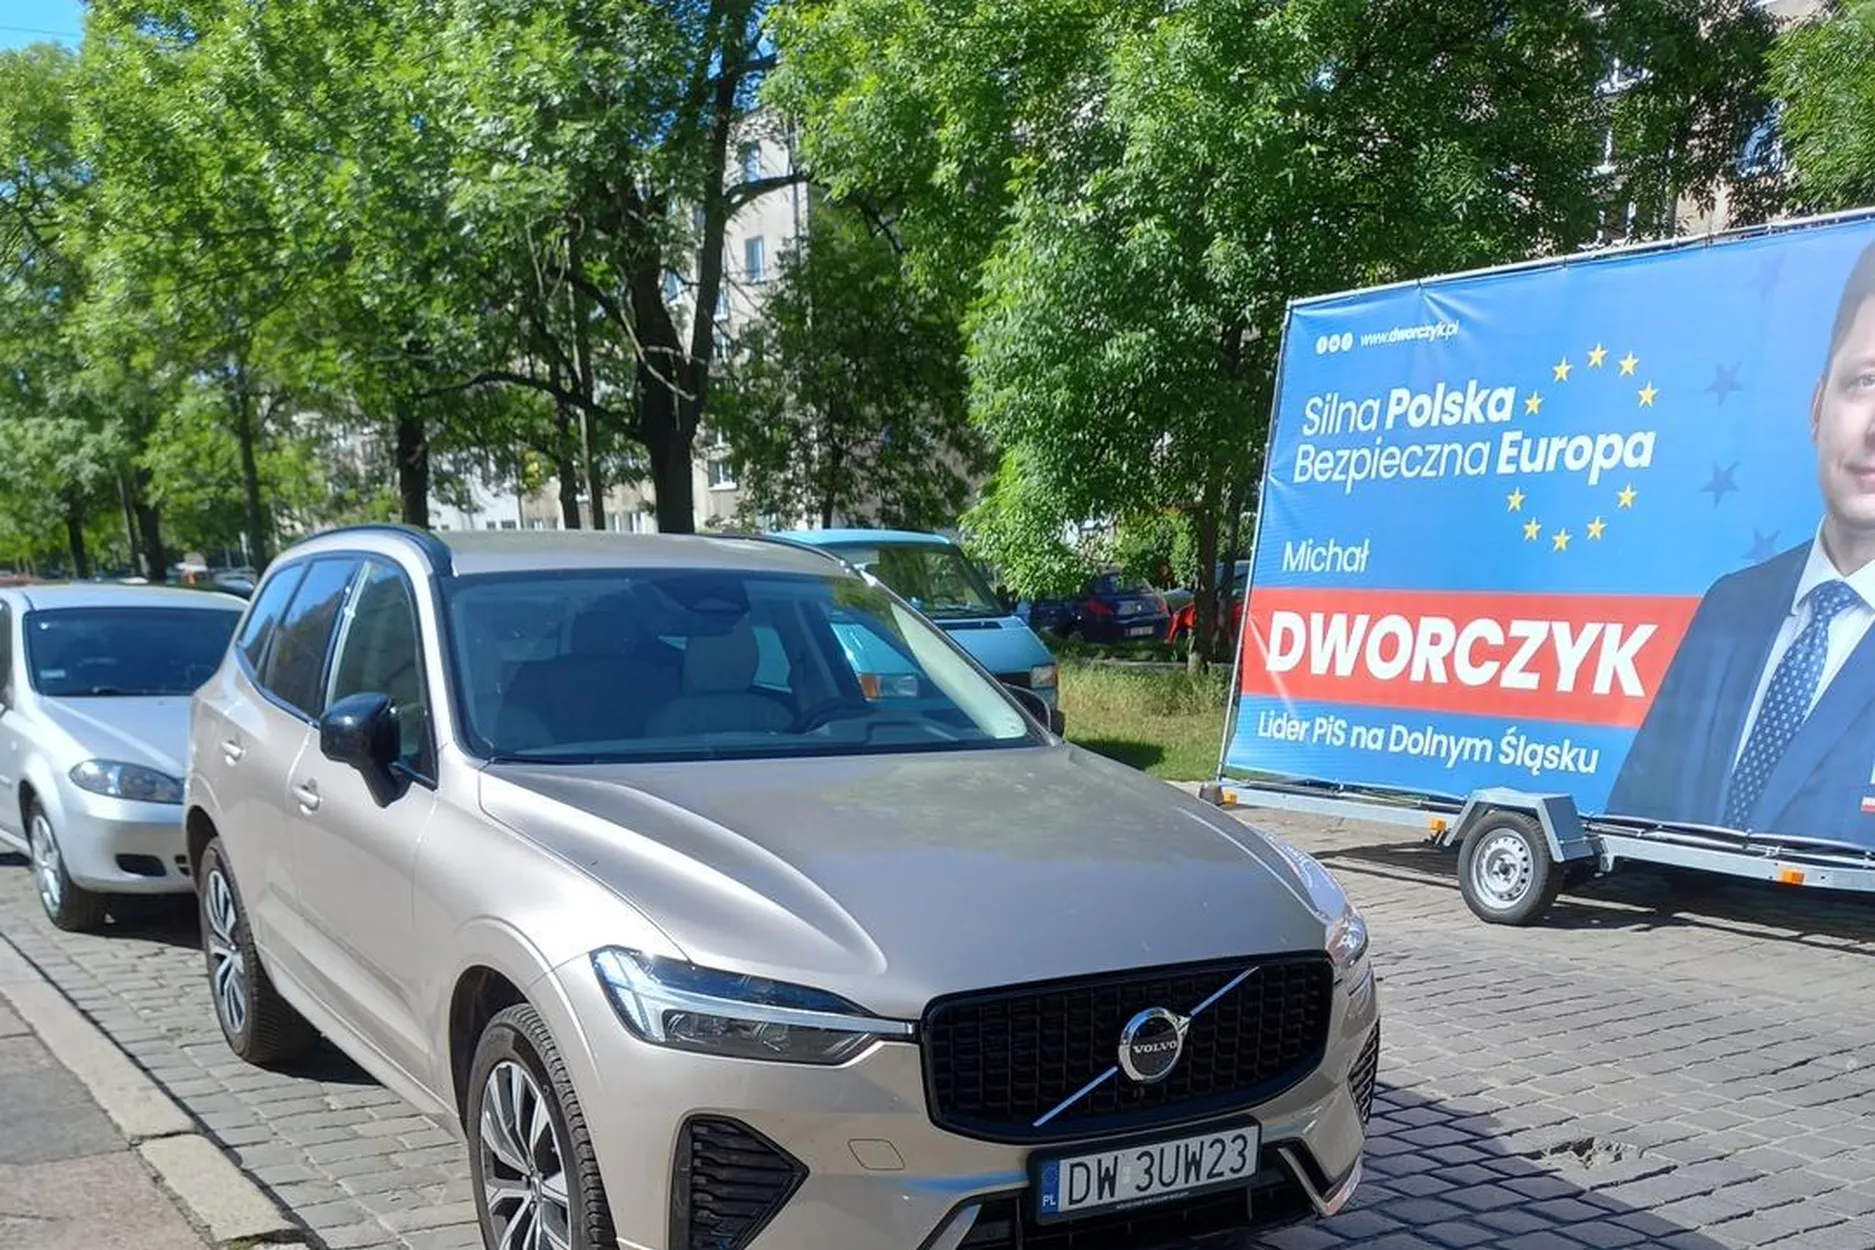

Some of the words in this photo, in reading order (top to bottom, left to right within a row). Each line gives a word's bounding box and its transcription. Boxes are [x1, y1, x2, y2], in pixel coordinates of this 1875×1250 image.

[1360, 320, 1460, 346] www.dworczyk.pl
[1302, 392, 1381, 436] Silna
[1385, 379, 1517, 430] Polska
[1293, 436, 1491, 495] Bezpieczna
[1496, 430, 1656, 486] Europa
[1282, 538, 1370, 573] Michał
[1265, 610, 1658, 697] DWORCZYK
[1258, 709, 1310, 742] Lider
[1312, 715, 1347, 747] PiS
[1350, 724, 1385, 751] na
[1388, 723, 1492, 768] Dolnym
[1498, 725, 1599, 776] Śląsku
[1132, 1040, 1177, 1054] VOLVO
[1069, 1156, 1119, 1206] DW
[1134, 1133, 1249, 1193] 3UW23
[1042, 1194, 1057, 1207] PL
